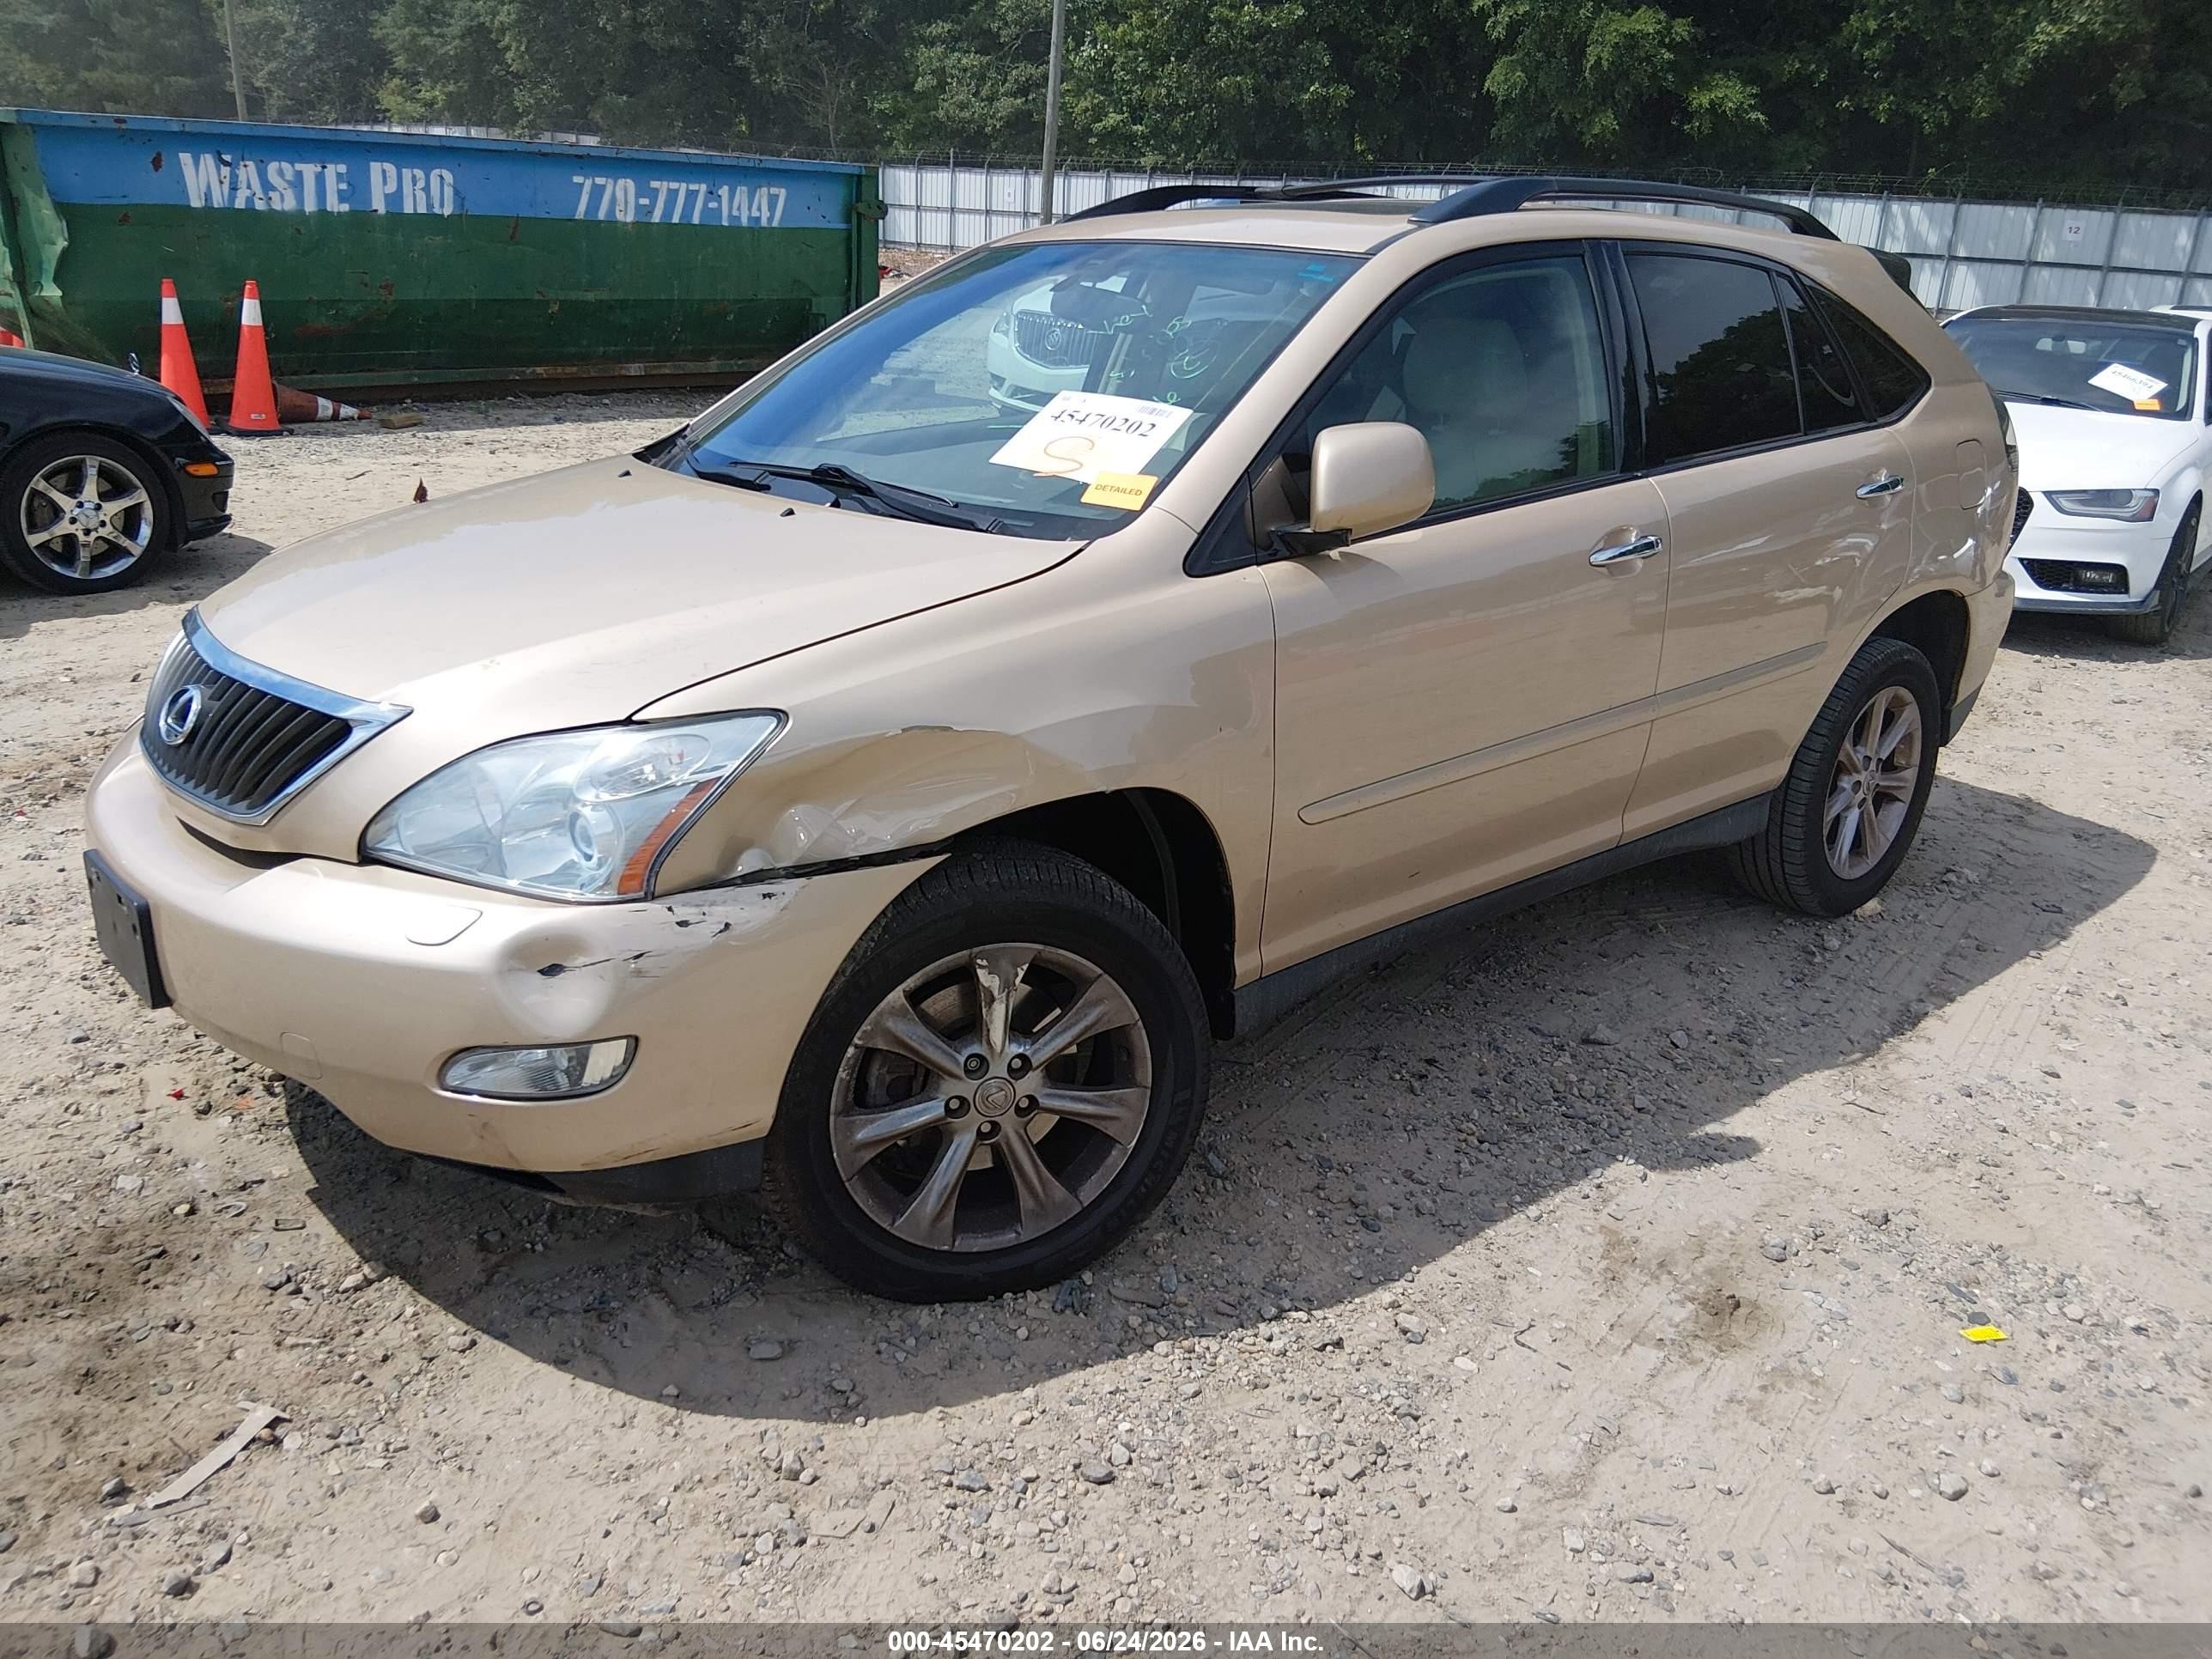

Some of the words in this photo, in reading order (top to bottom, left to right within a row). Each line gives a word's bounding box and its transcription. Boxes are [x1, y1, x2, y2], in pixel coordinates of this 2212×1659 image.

[178, 152, 348, 213] WASTE
[369, 161, 453, 216] PRO
[572, 175, 786, 227] 770-777-1447
[2068, 226, 2081, 234] 12
[1050, 409, 1157, 437] 45470202
[1094, 483, 1143, 497] DETAILED
